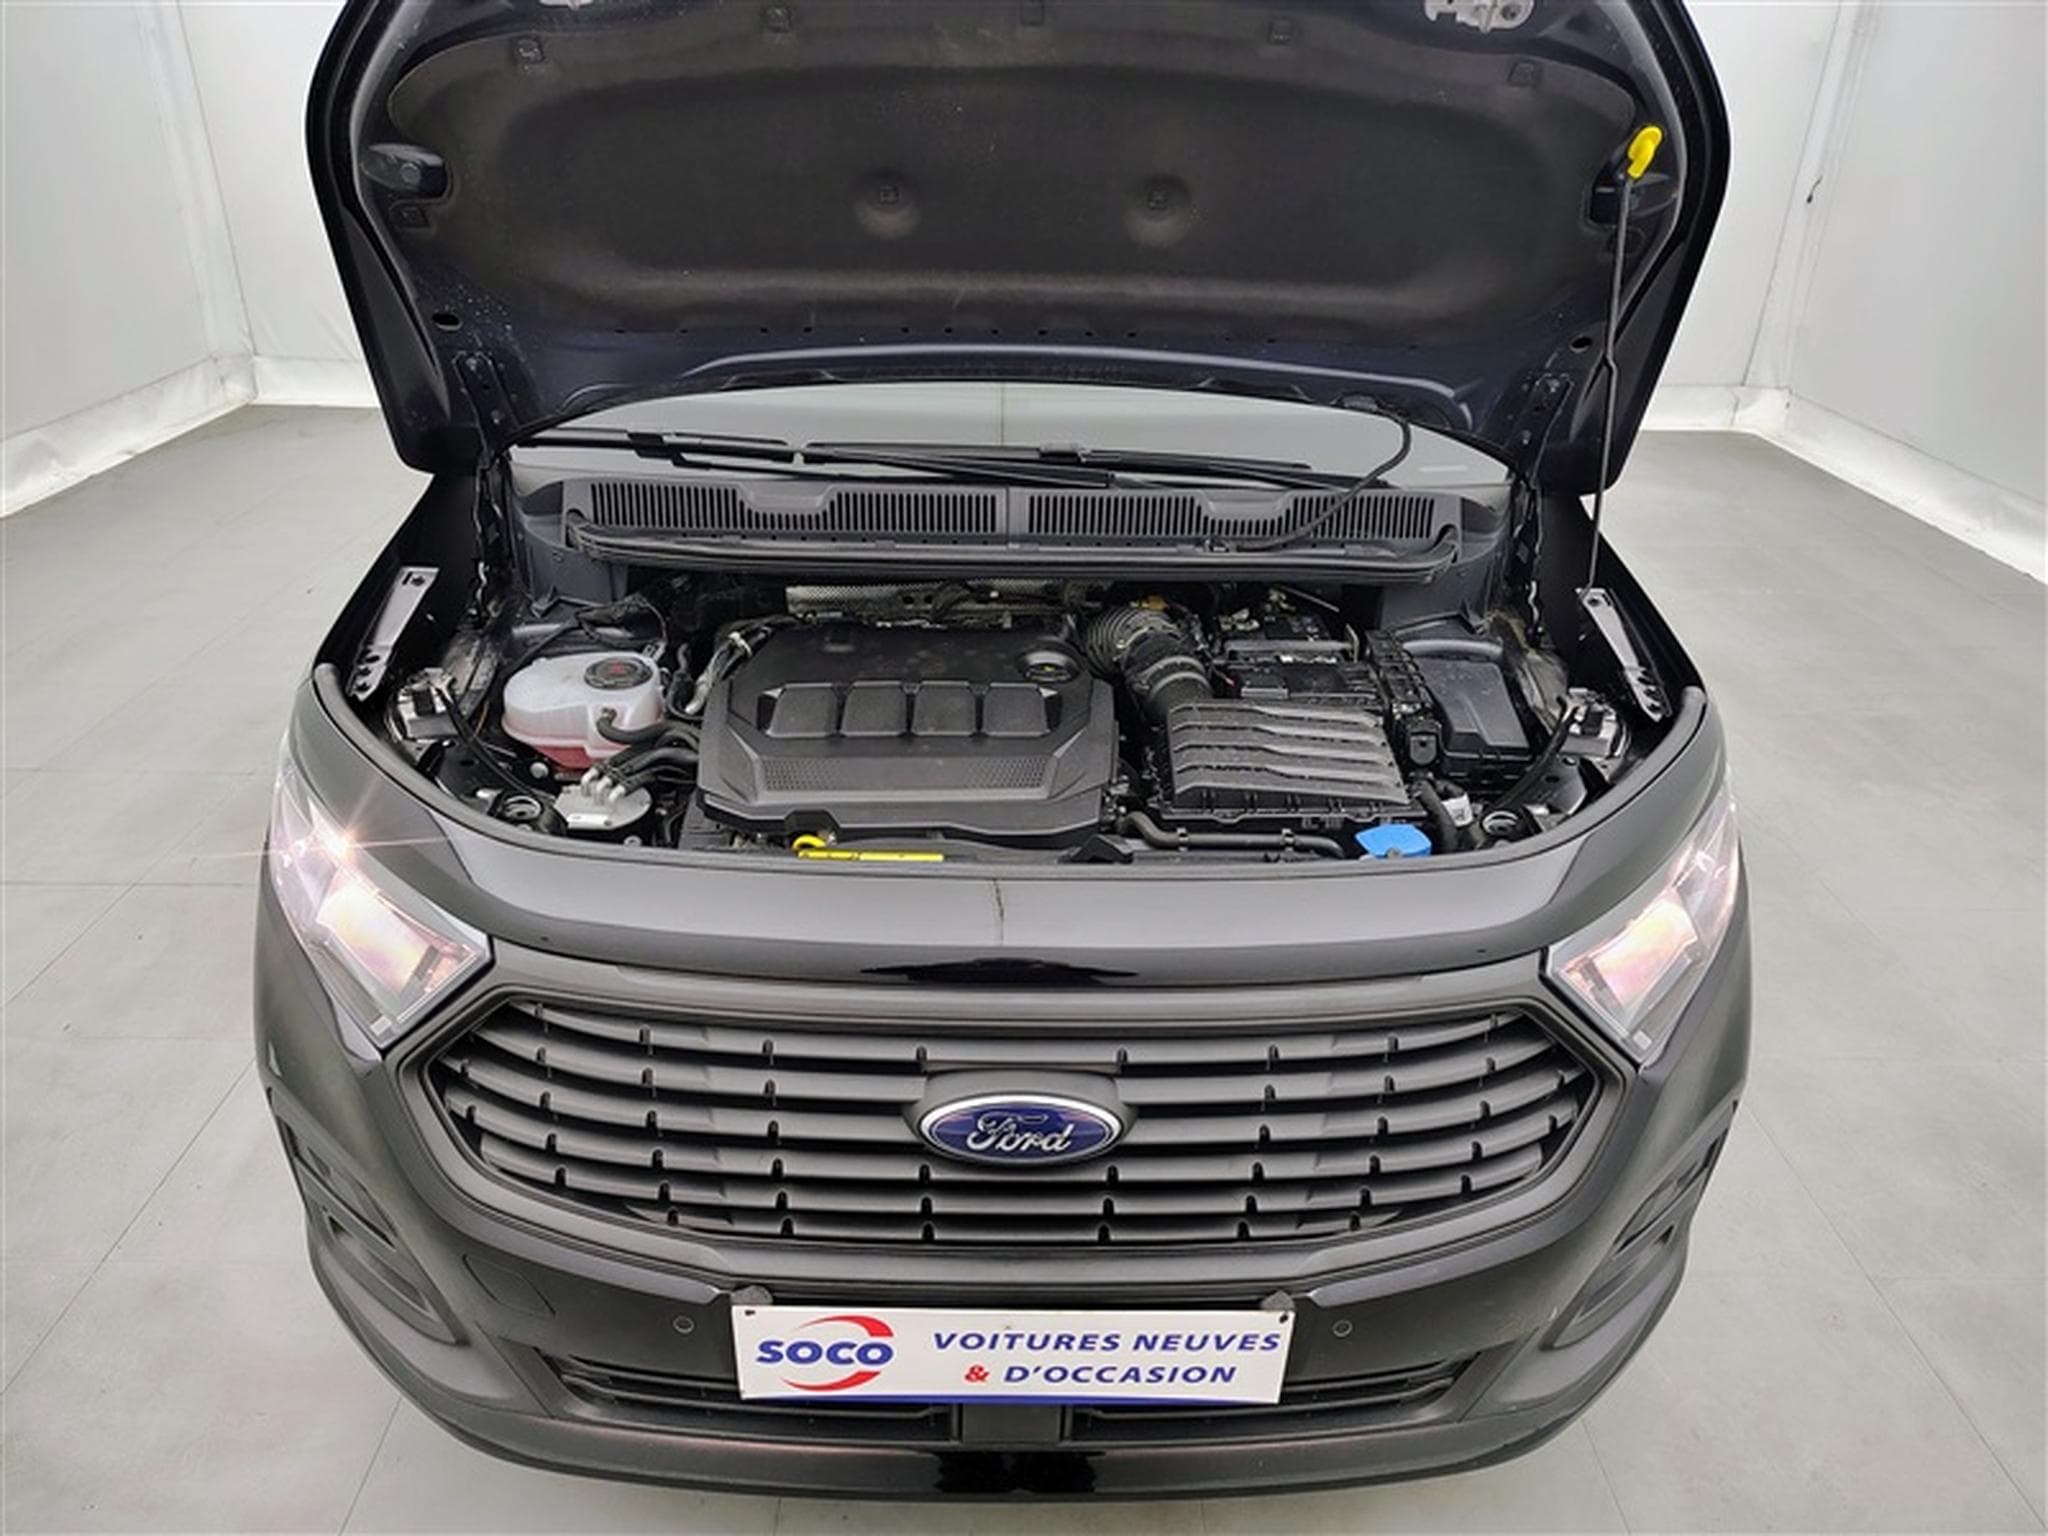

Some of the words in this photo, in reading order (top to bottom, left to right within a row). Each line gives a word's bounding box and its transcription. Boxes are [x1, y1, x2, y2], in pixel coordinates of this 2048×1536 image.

[966, 1111, 1075, 1151] Ford
[756, 1340, 894, 1366] SOCO
[934, 1332, 1121, 1351] VOITURES
[1132, 1333, 1281, 1351] NEUVES
[964, 1364, 990, 1383] &
[1004, 1366, 1237, 1384] D'OCCASION
